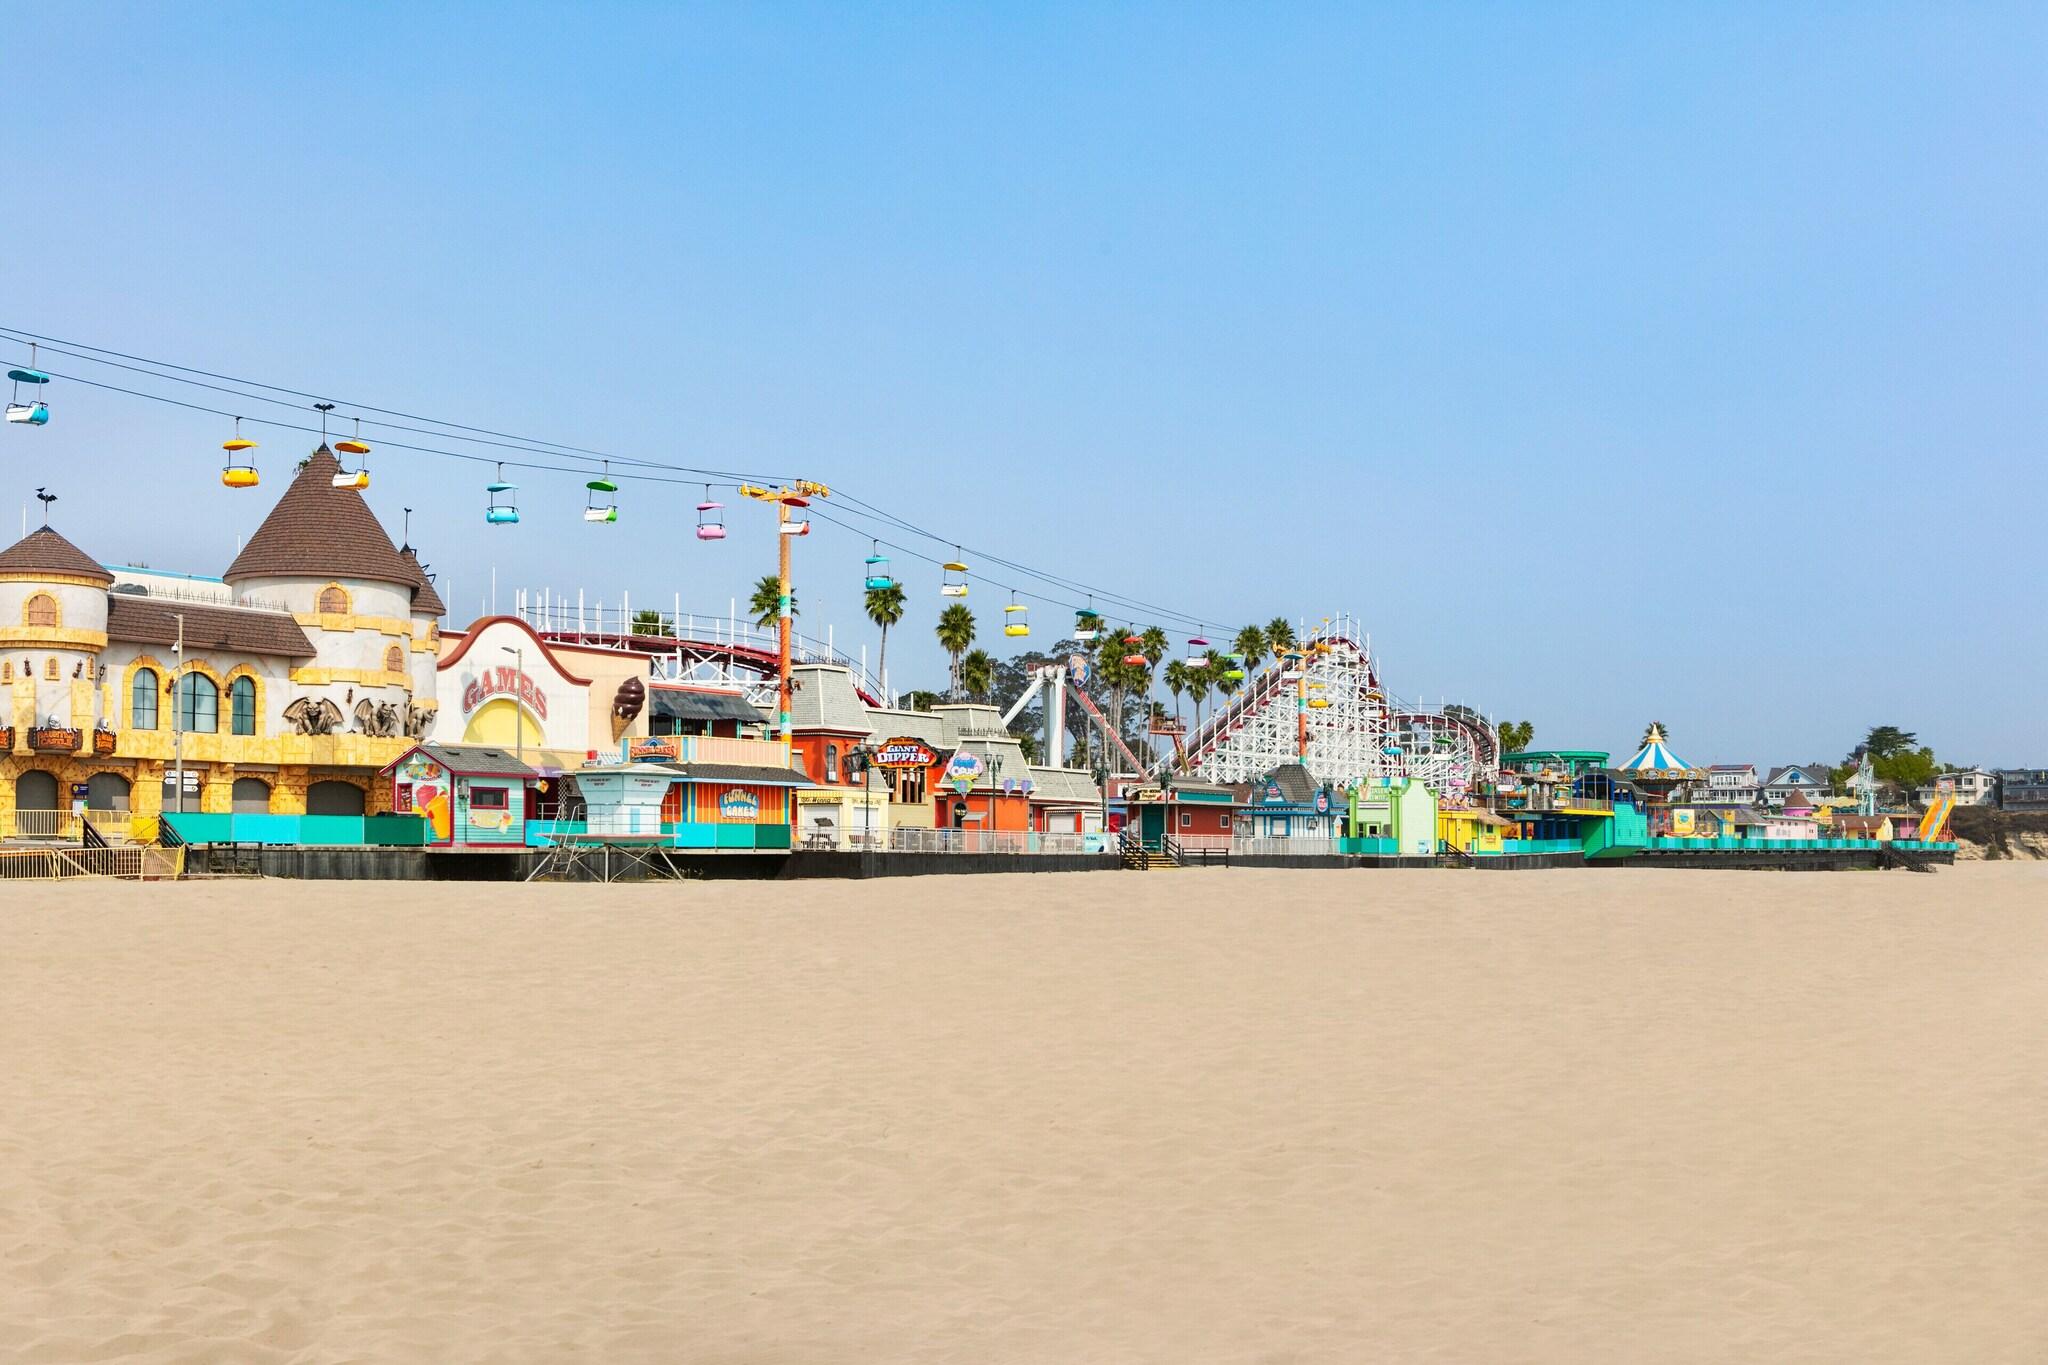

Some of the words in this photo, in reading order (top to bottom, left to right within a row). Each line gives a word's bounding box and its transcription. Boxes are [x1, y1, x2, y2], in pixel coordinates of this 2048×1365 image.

[463, 665, 547, 721] GAMES
[886, 745, 919, 753] GIANT
[876, 752, 930, 763] DIPPER
[723, 789, 757, 806] FUNNEL
[726, 806, 756, 817] CAKES
